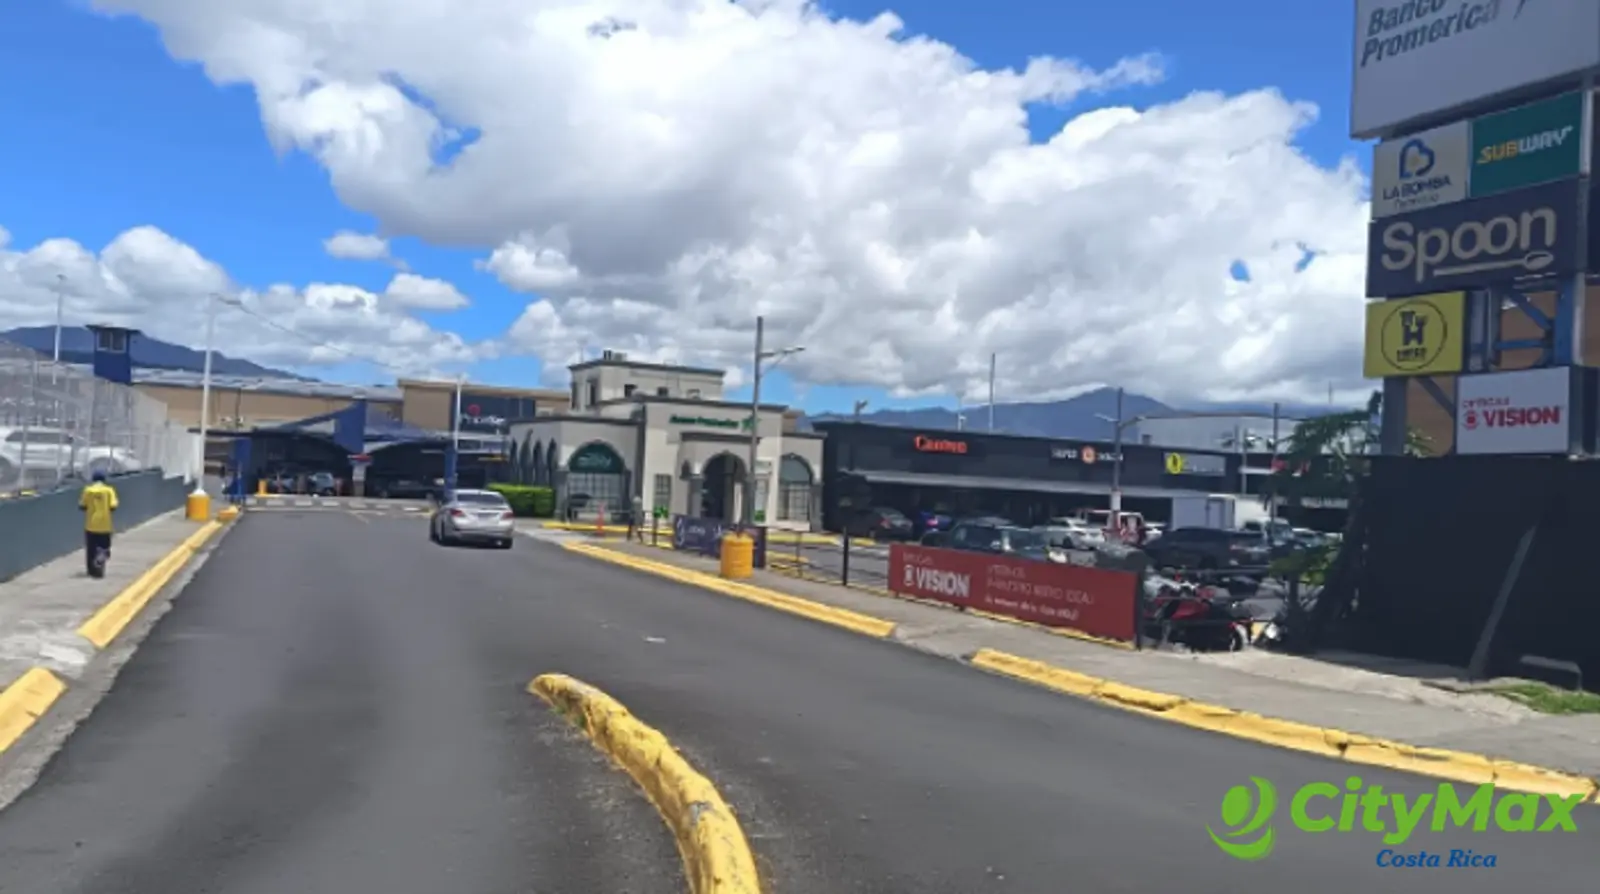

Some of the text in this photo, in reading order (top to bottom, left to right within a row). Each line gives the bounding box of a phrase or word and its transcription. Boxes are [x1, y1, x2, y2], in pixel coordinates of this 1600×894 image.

[1360, 0, 1500, 67] Promerica
[1477, 126, 1573, 164] SUBWAY
[1381, 208, 1557, 283] Spoon
[1483, 405, 1560, 427] VISION
[916, 567, 971, 598] VISION
